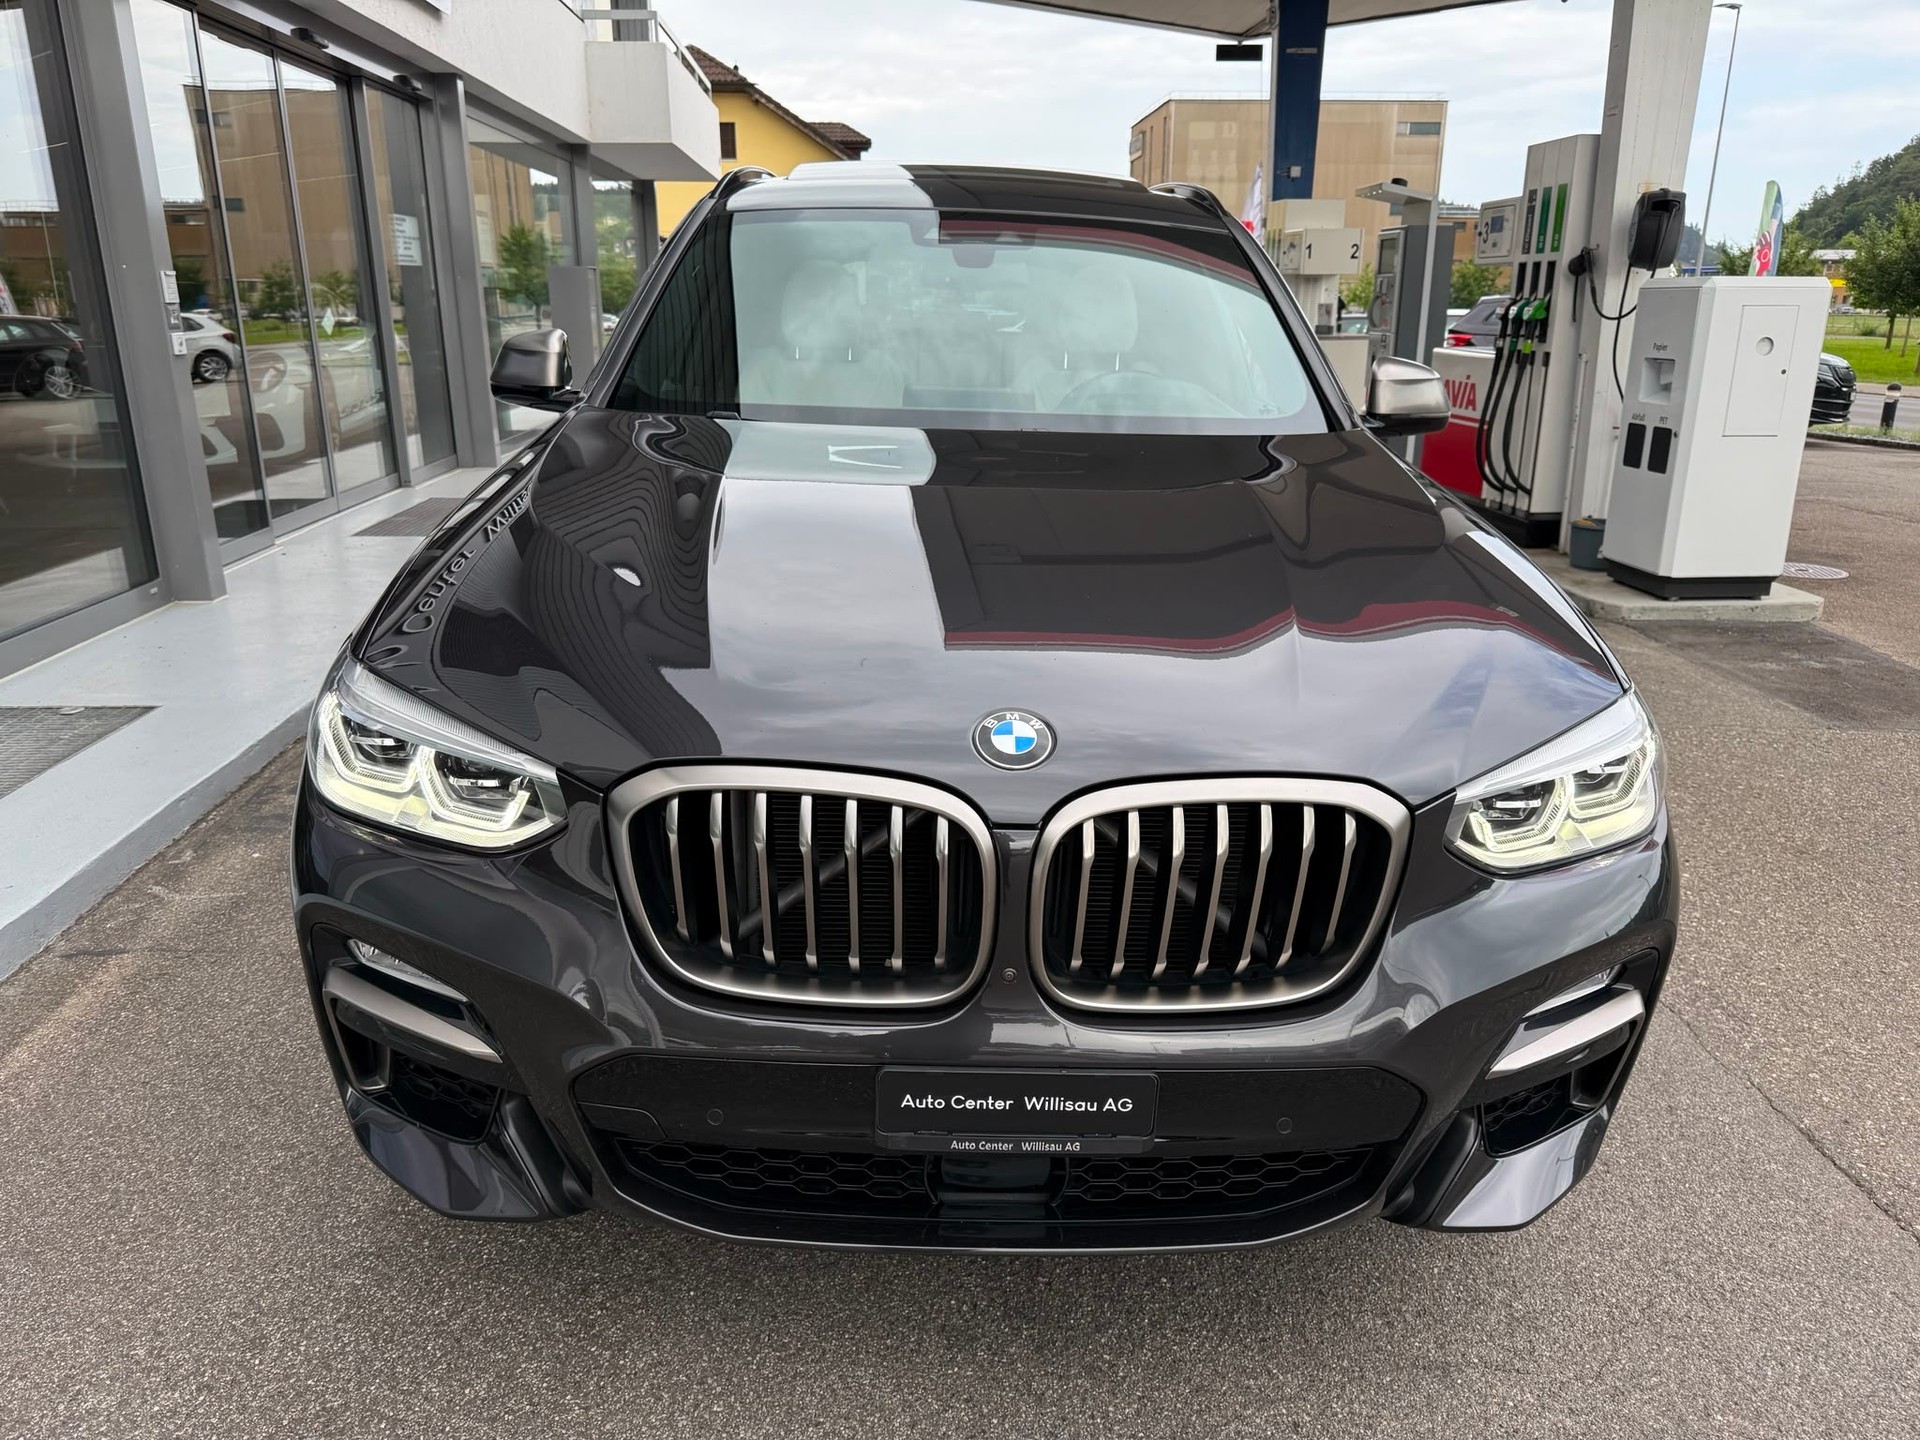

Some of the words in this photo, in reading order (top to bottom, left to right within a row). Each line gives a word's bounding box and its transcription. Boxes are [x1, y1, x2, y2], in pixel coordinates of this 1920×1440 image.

[1482, 221, 1490, 244] 3
[1305, 243, 1312, 260] 1
[1350, 243, 1360, 260] 2
[983, 712, 1044, 730] BMW
[900, 1094, 945, 1109] Auto
[951, 1095, 1014, 1110] Center
[1024, 1096, 1098, 1112] Willisau
[1103, 1098, 1133, 1112] AG
[950, 1140, 976, 1150] Auto
[978, 1141, 1014, 1151] Center
[1021, 1142, 1062, 1152] Willisau
[1064, 1142, 1081, 1152] AG
